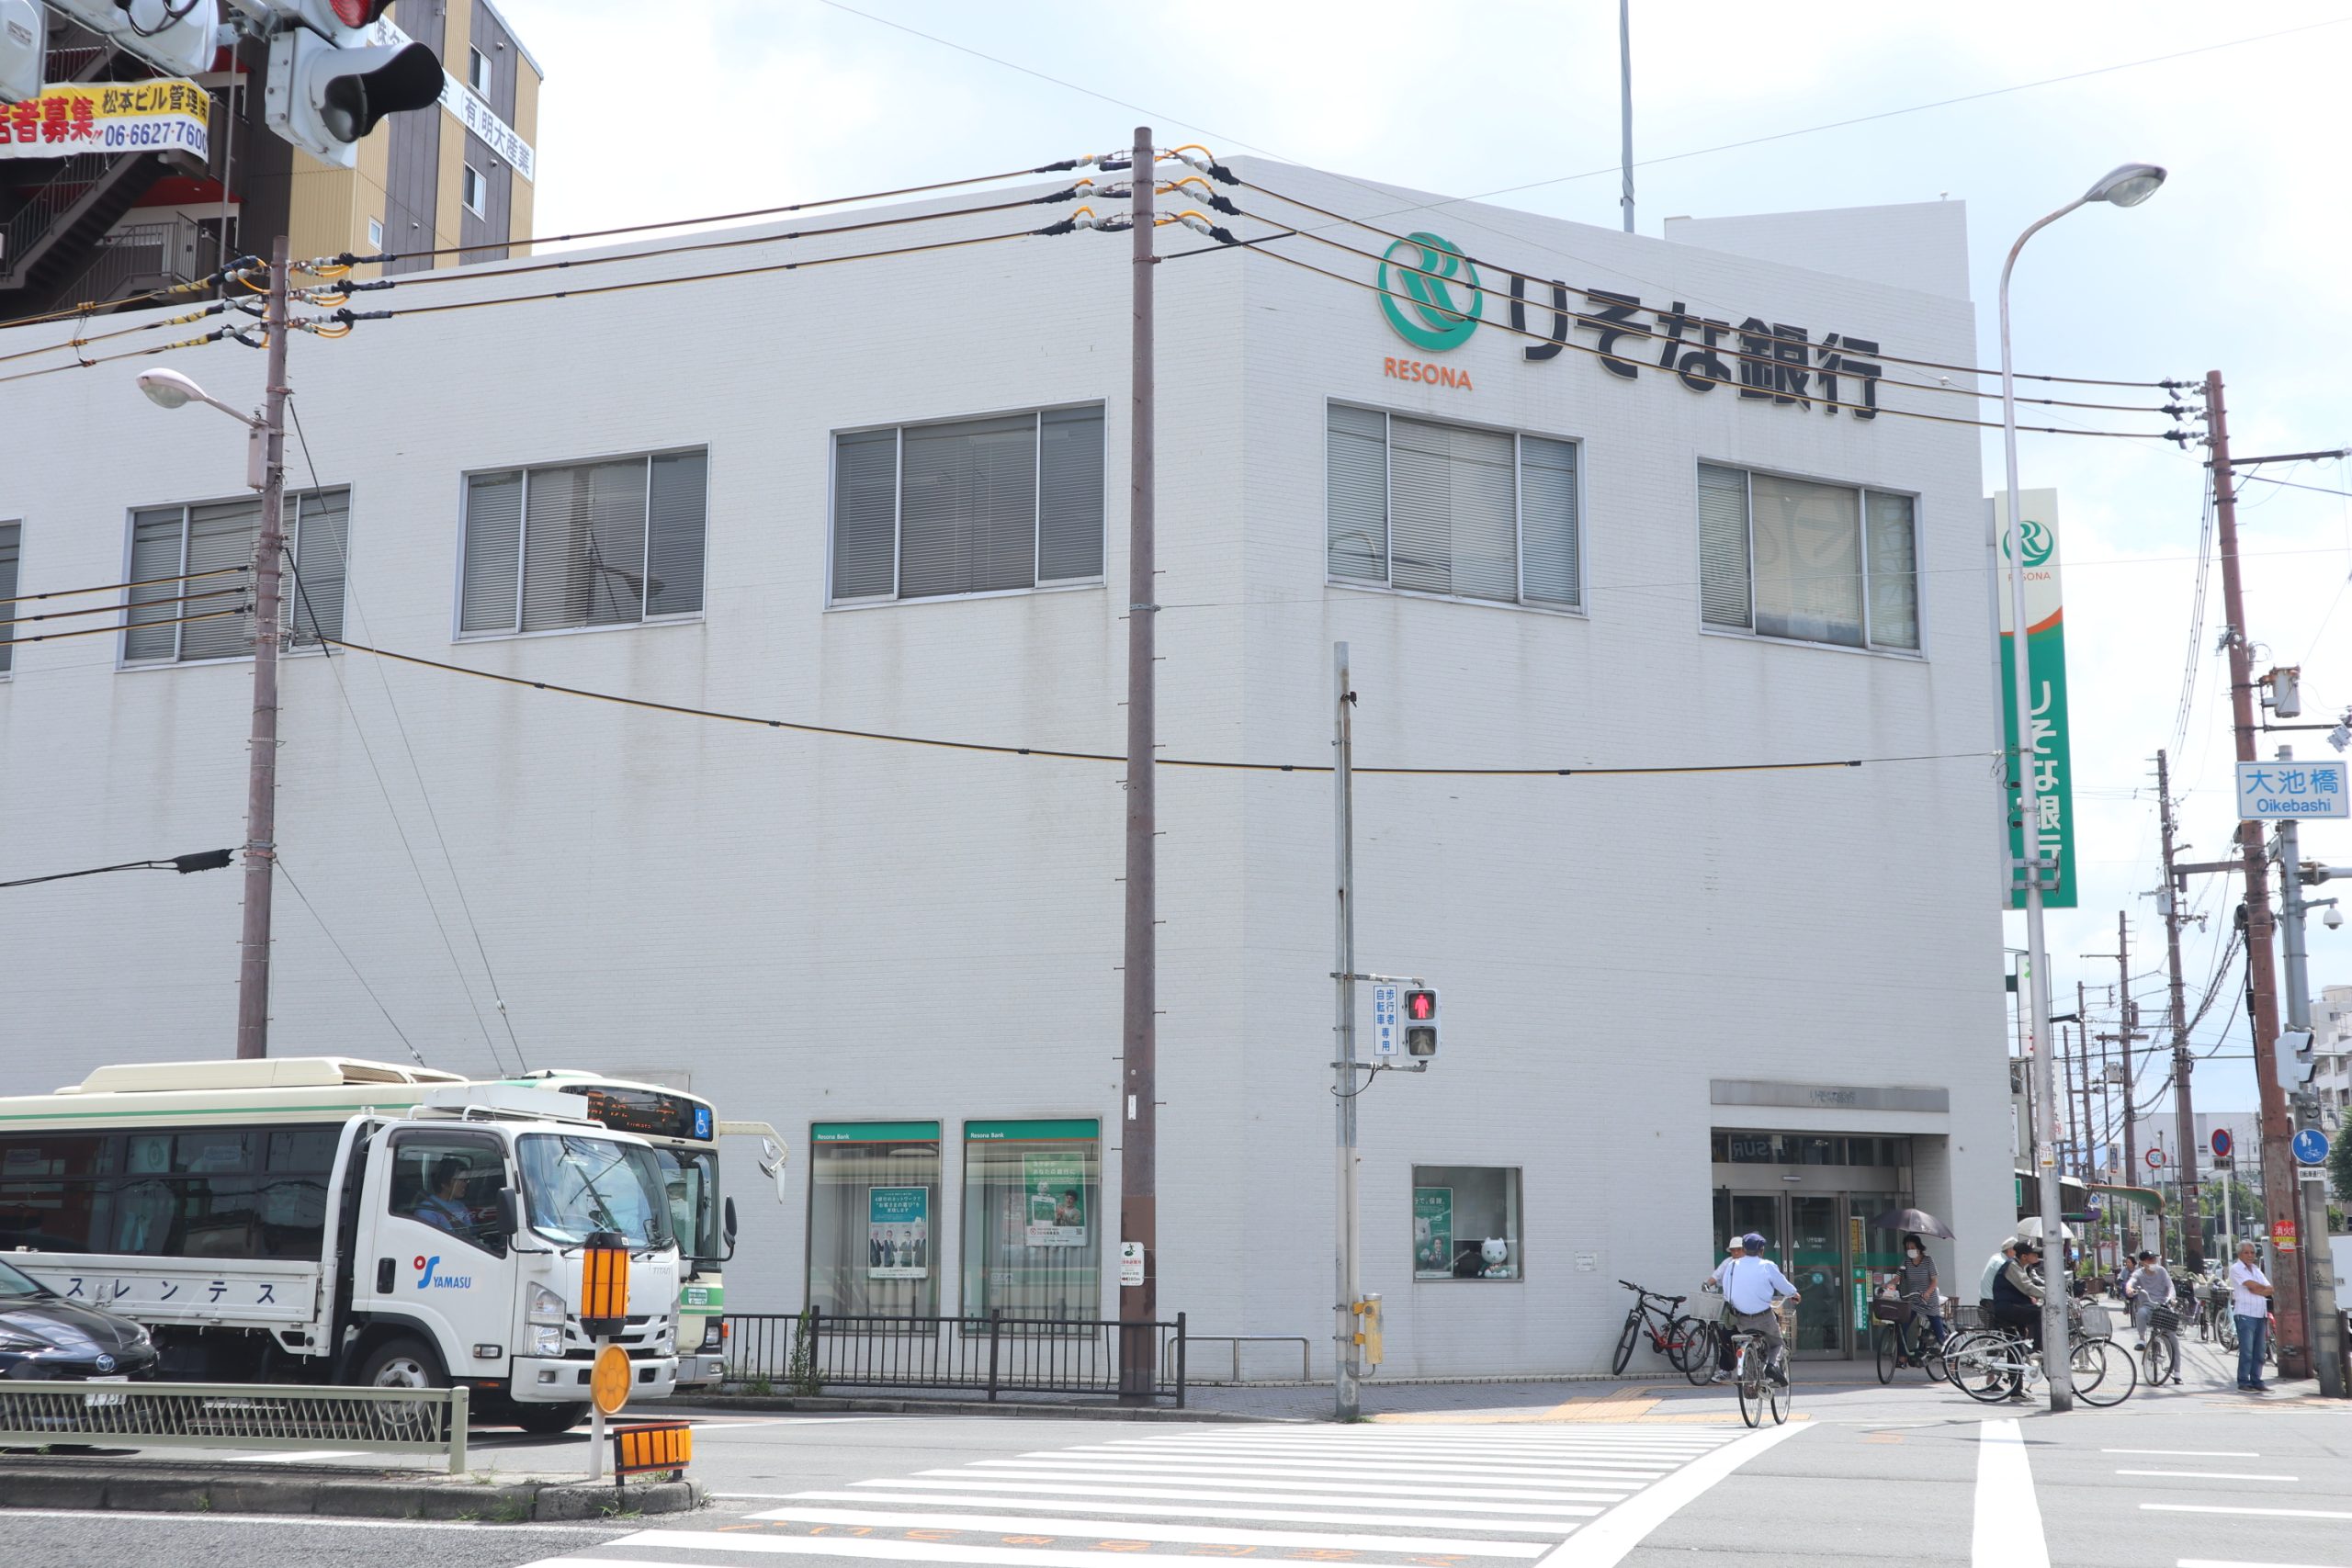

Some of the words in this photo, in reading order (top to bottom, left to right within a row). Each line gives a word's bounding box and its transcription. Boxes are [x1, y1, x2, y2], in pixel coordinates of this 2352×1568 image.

[1508, 273, 1883, 421] りそな銀行
[1384, 356, 1474, 391] RESONA
[2007, 571, 2052, 581] RSONA
[2245, 769, 2339, 795] 大池橋
[2256, 798, 2332, 813] Oikebashi
[1376, 989, 1385, 1025] 自転車
[1385, 989, 1395, 1025] 歩行者
[1381, 1028, 1390, 1052] 専用
[434, 1277, 472, 1289] YAMASU
